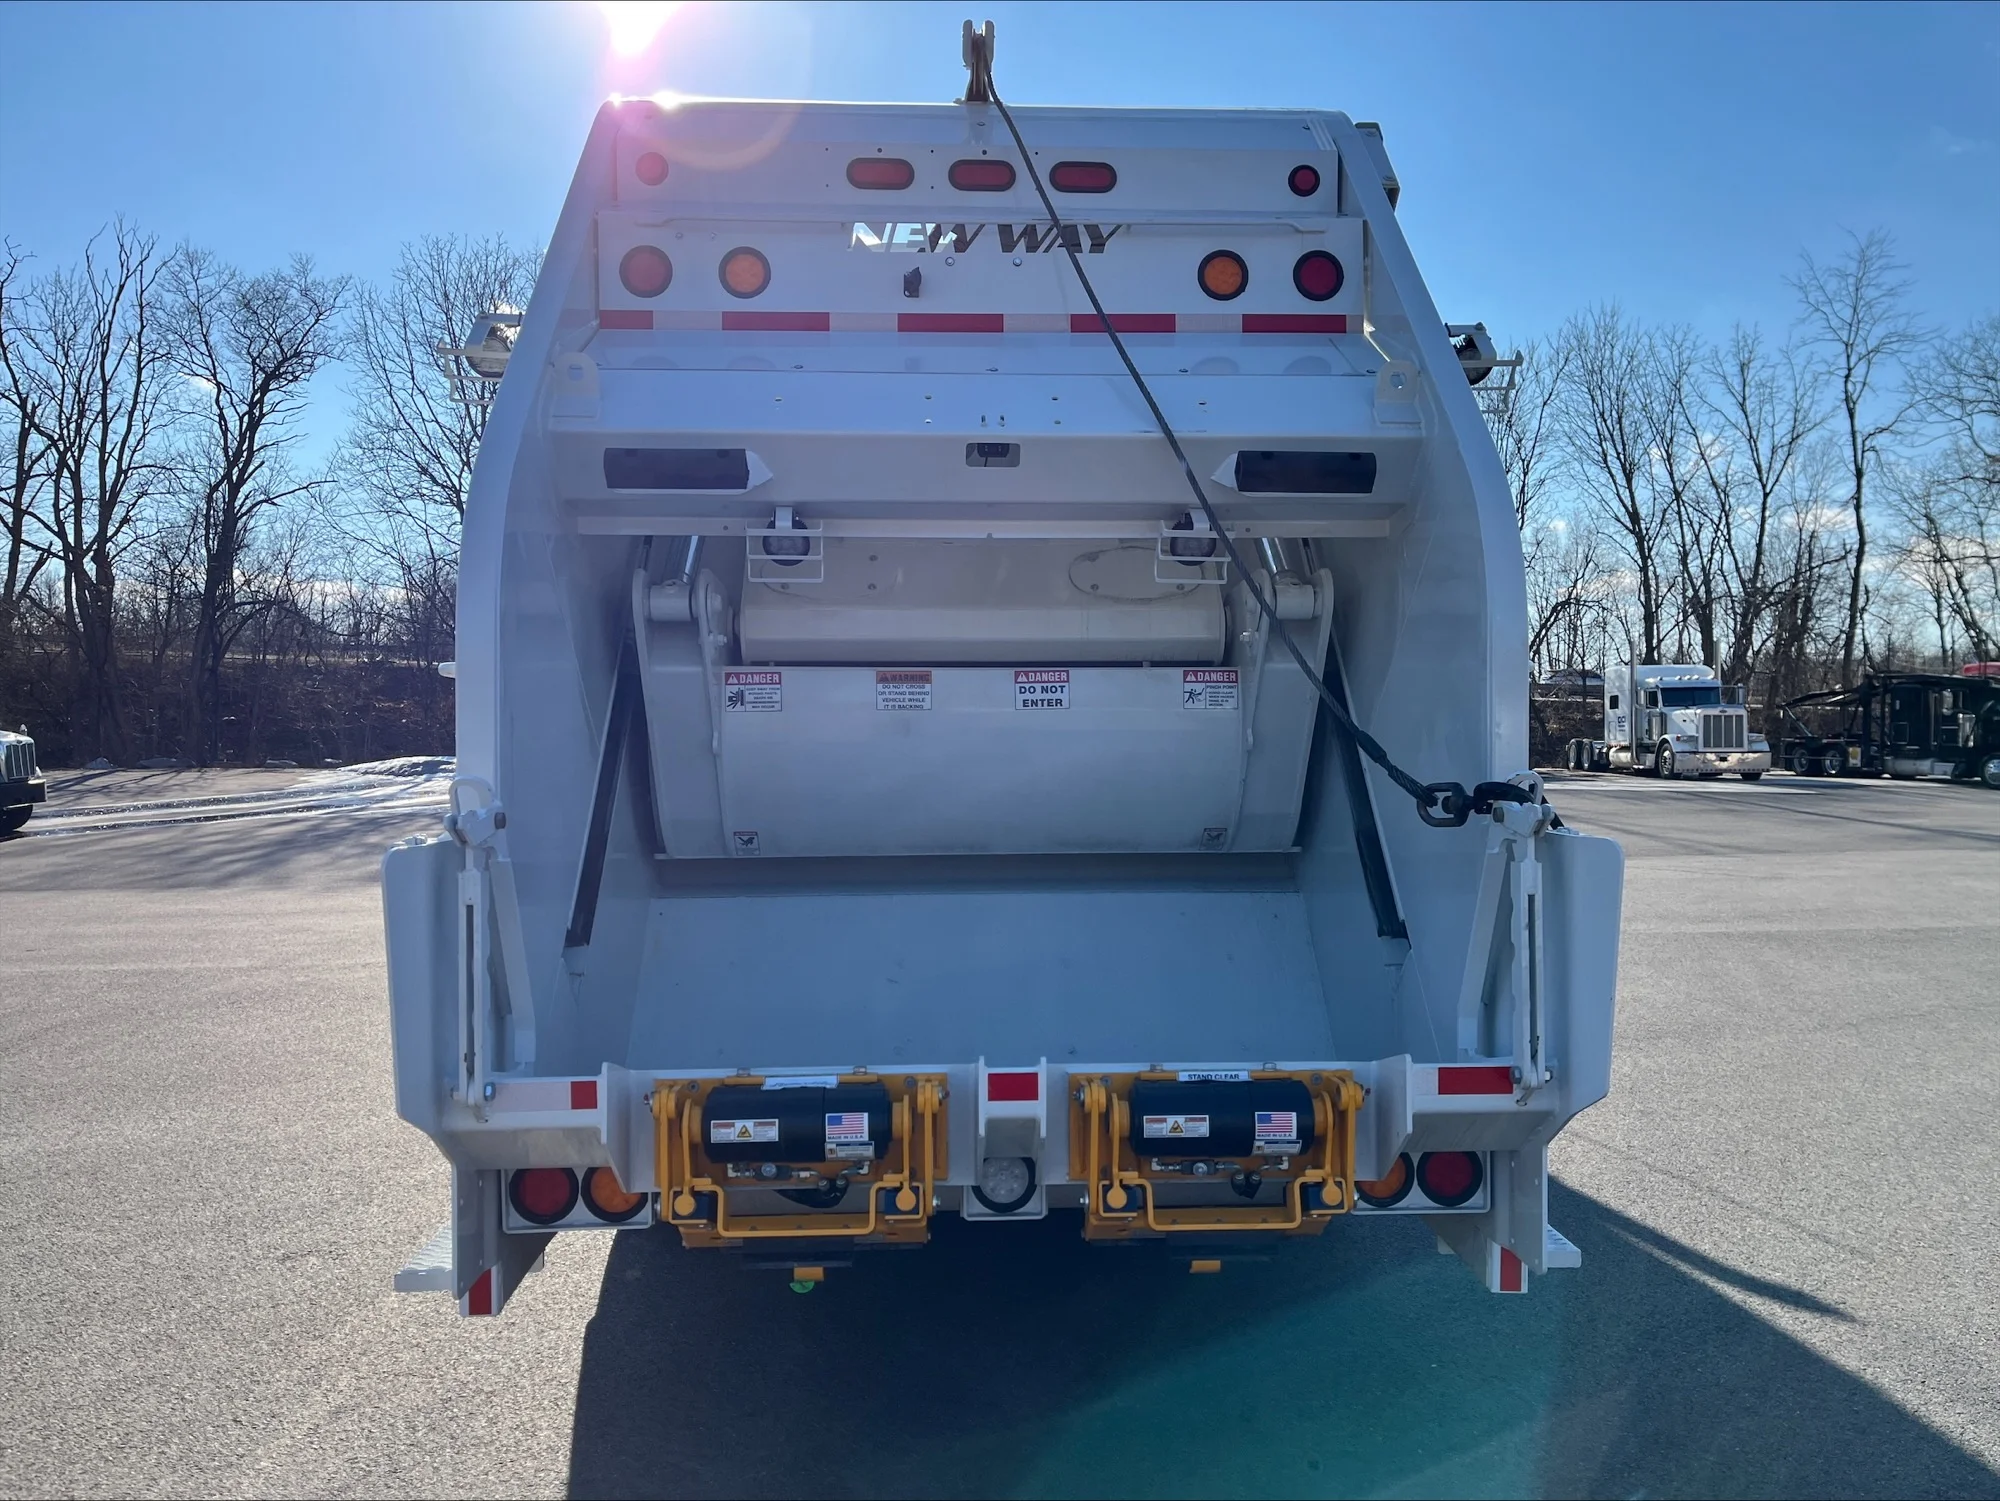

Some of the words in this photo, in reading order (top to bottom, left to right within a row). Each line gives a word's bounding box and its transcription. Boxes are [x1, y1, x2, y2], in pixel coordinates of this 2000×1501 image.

[851, 223, 985, 253] NEW
[998, 223, 1122, 253] WAY
[740, 674, 779, 684] DANGER
[1028, 672, 1067, 682] DANGER
[1198, 672, 1236, 681] DANGER
[1019, 685, 1036, 694] DO
[1041, 685, 1066, 694] NOT
[1022, 699, 1063, 707] ENTER
